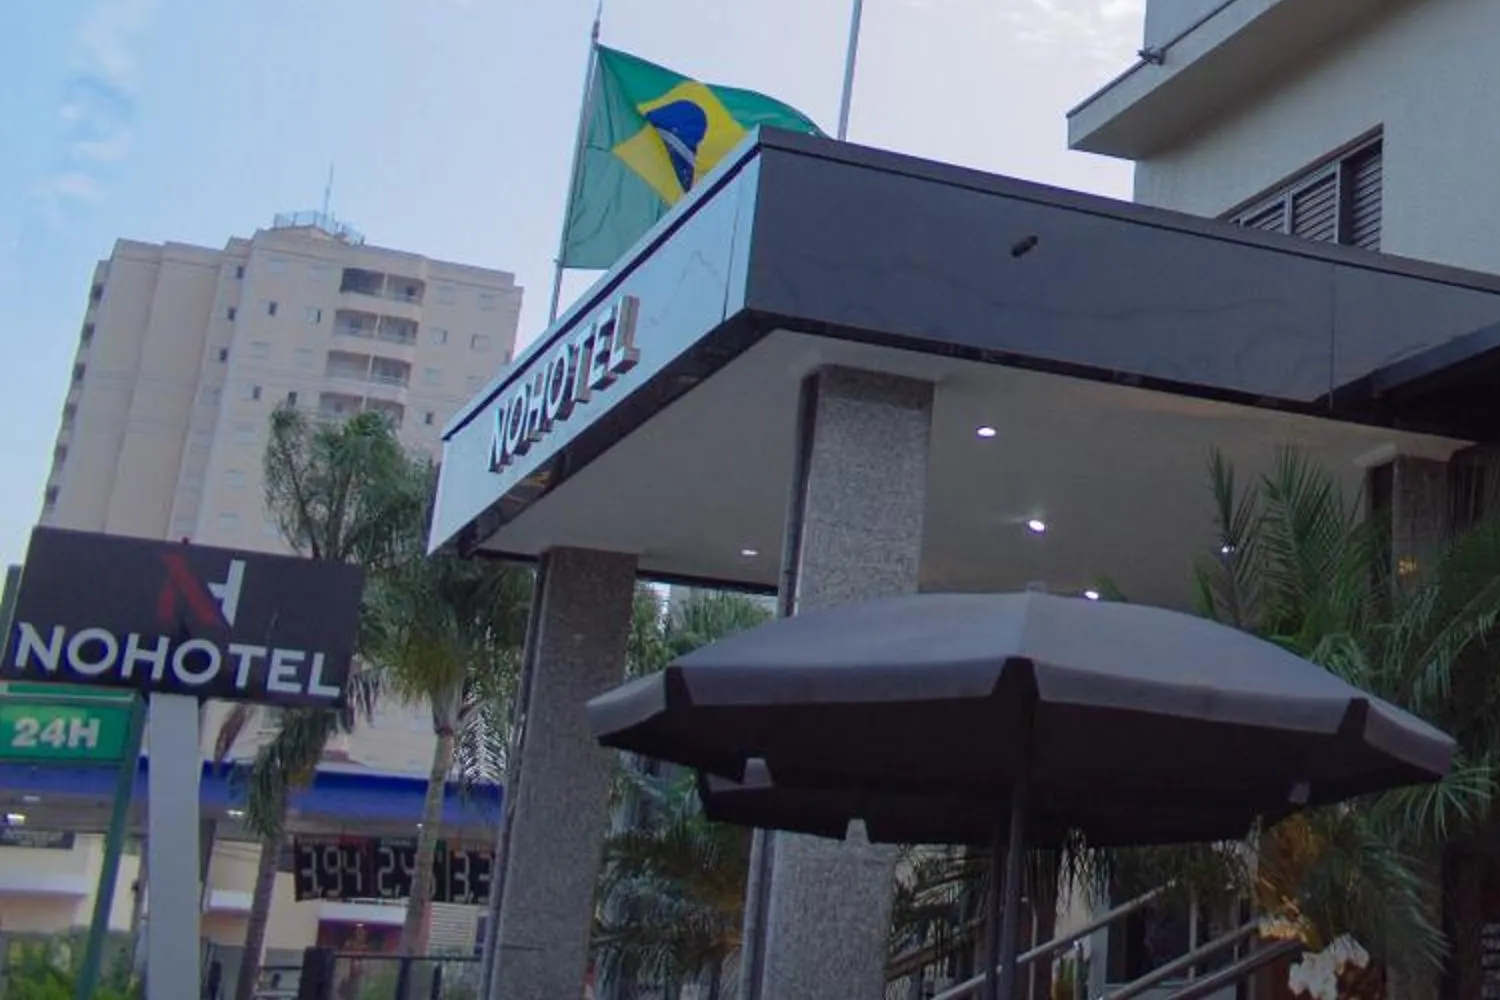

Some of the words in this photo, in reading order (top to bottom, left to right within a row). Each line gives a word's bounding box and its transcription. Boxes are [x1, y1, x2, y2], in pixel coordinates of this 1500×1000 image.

[488, 294, 641, 473] NOHOTEL
[14, 621, 341, 698] NOHOTEL
[11, 716, 101, 749] 24H
